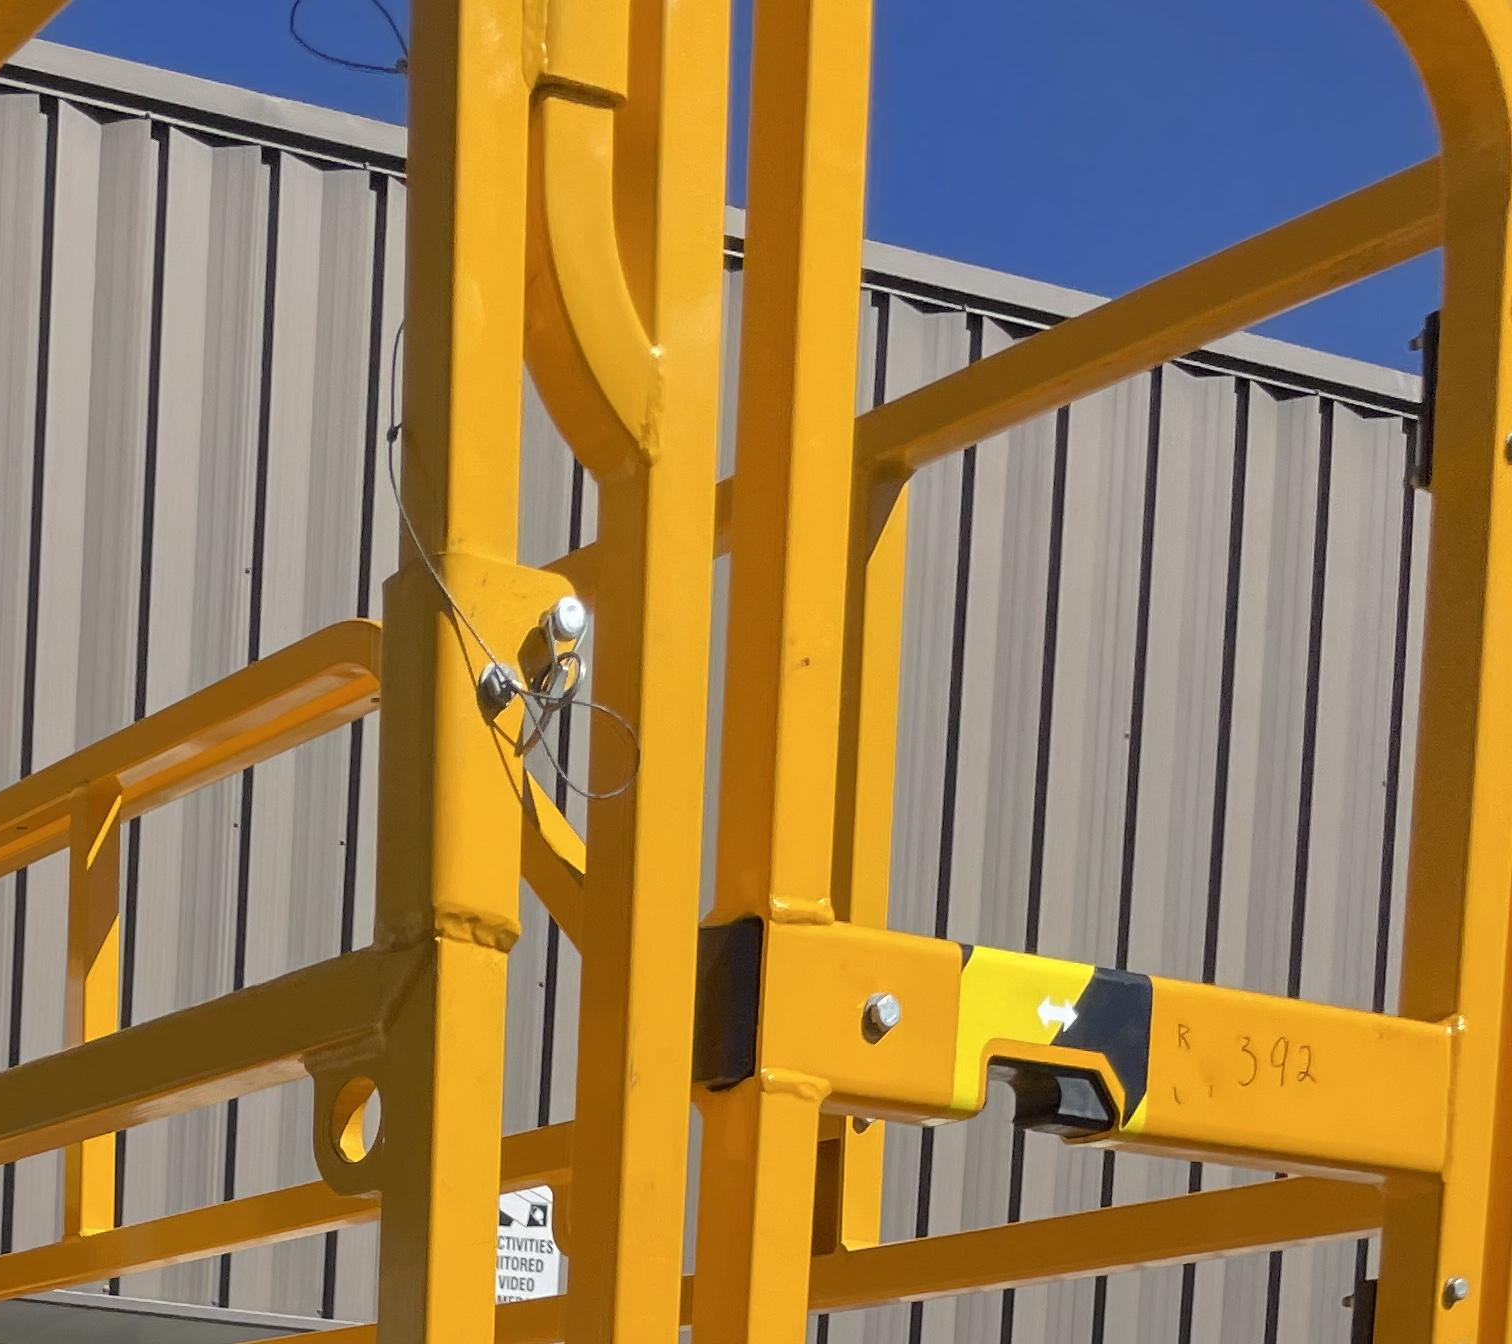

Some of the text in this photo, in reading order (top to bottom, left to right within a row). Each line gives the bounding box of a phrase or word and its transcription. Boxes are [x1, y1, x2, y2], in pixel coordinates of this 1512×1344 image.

[1238, 1036, 1317, 1086] 392
[497, 1236, 554, 1254] CTIVITIES
[498, 1275, 535, 1292] VIDEO
